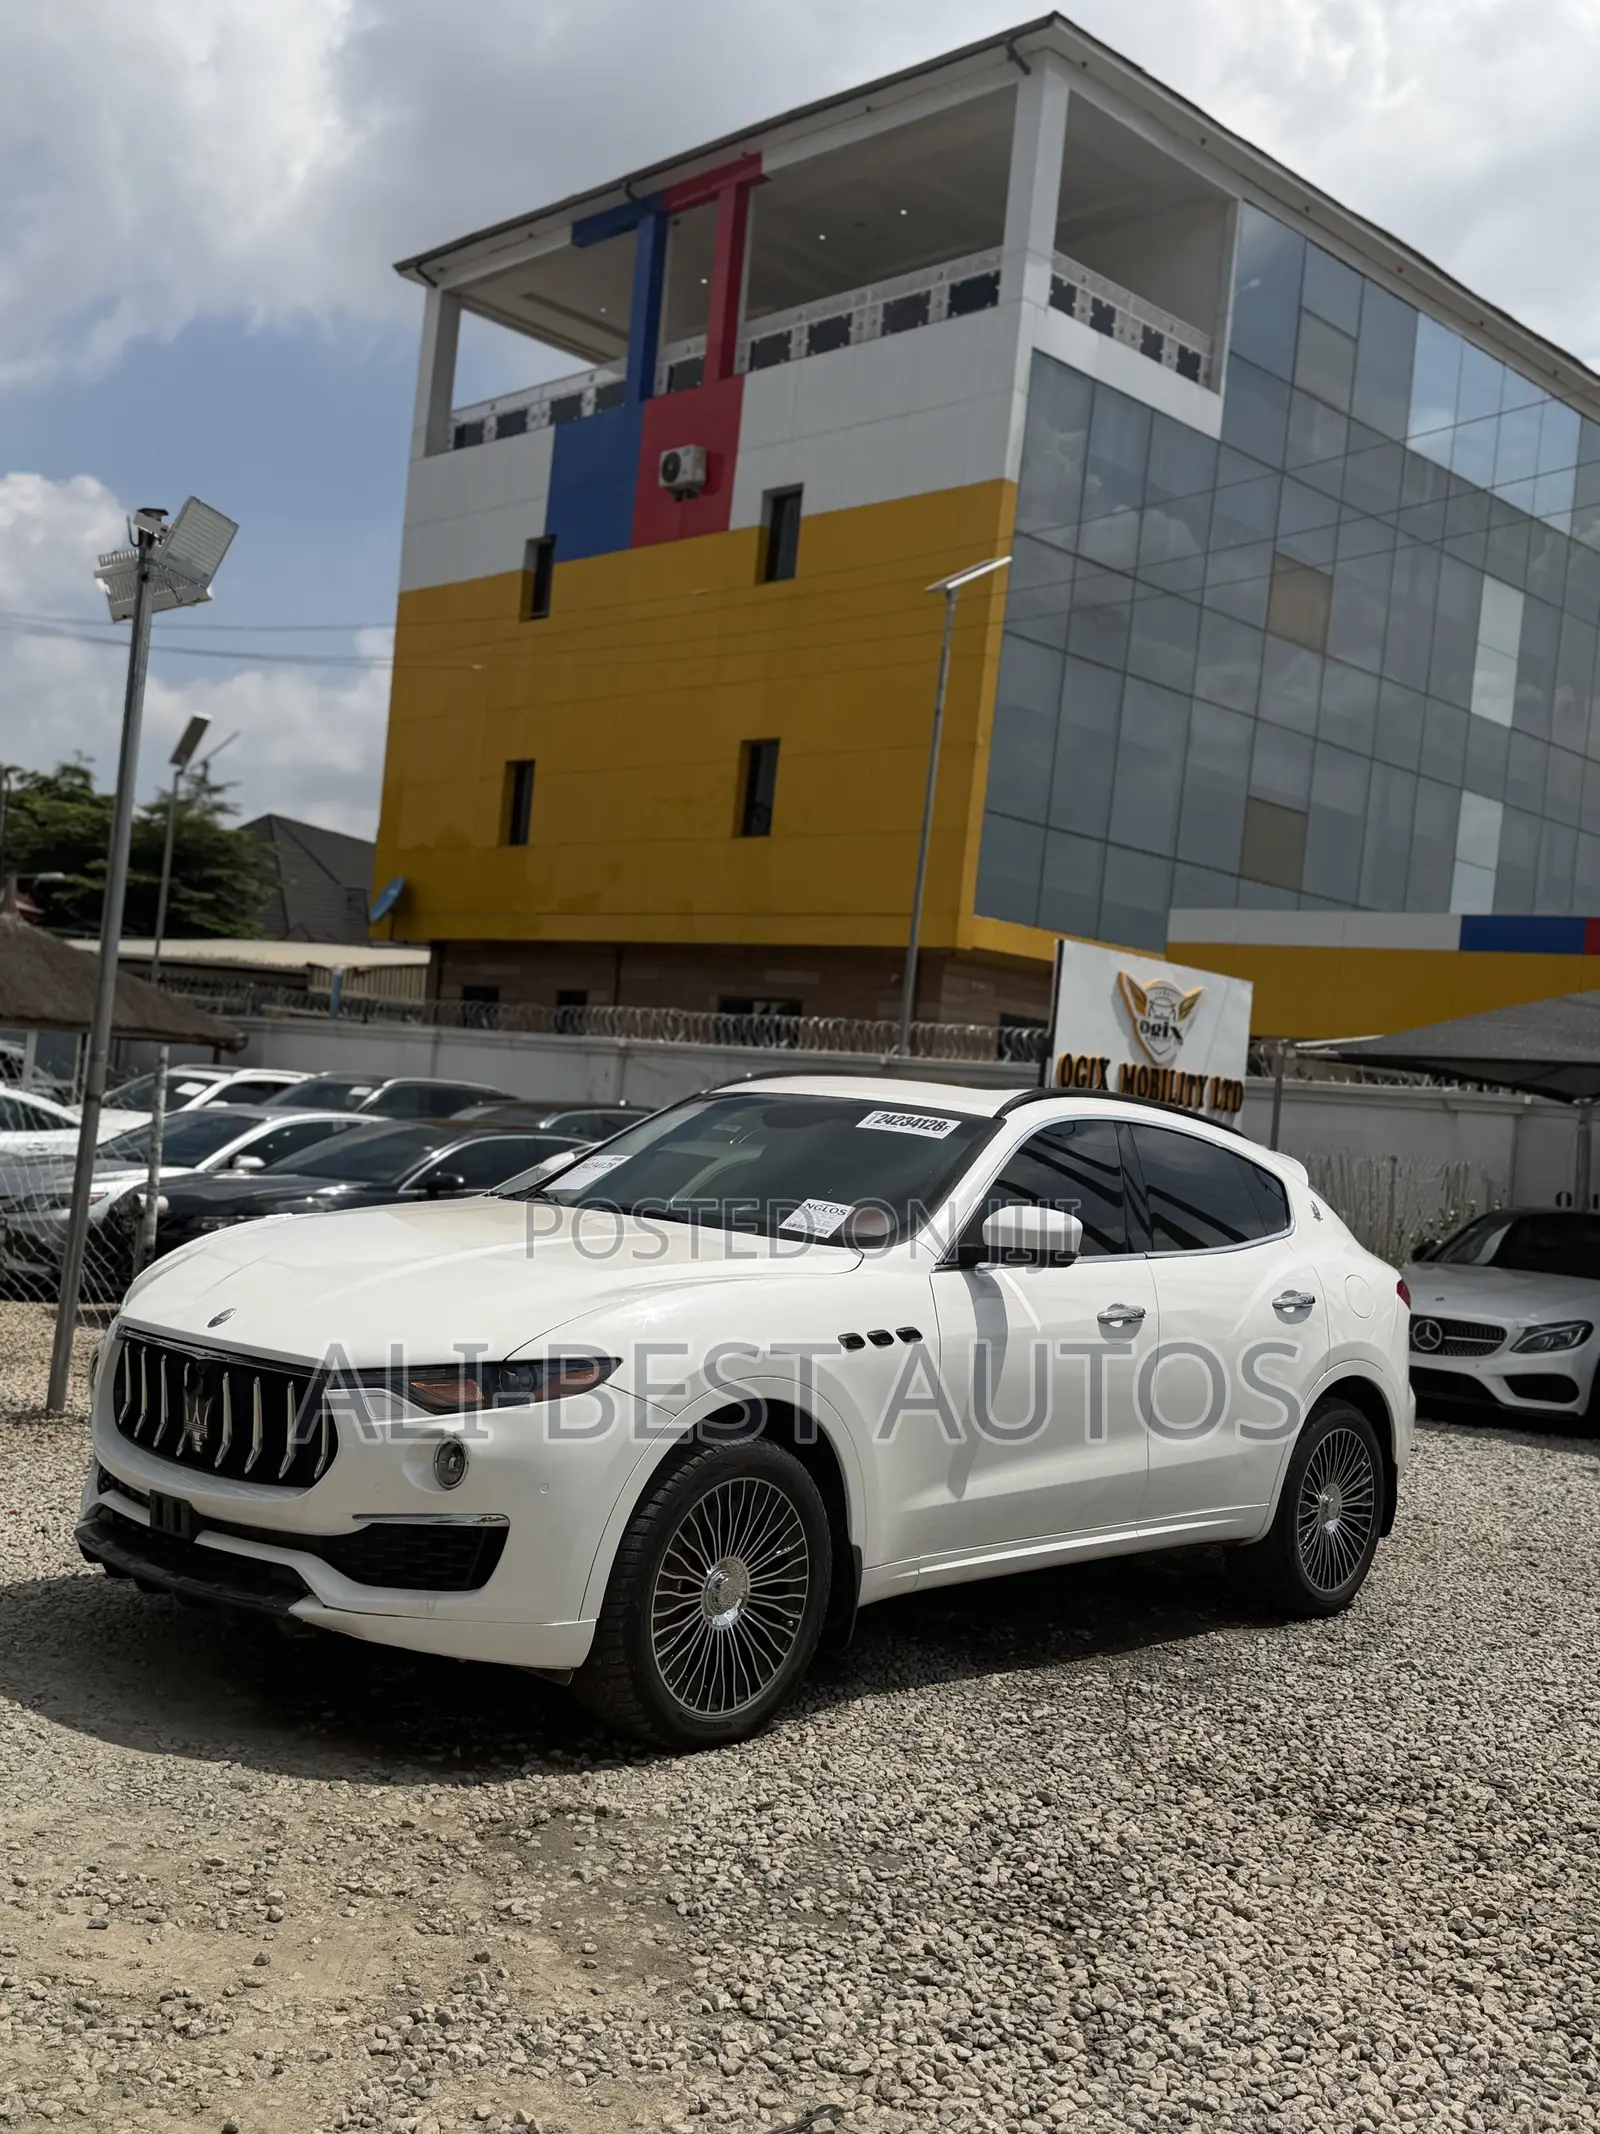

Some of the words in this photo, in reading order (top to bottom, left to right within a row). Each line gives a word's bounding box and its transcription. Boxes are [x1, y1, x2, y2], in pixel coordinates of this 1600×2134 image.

[1057, 1053, 1111, 1091] OGIX
[1118, 1063, 1208, 1110] MOBILITY
[1210, 1076, 1245, 1113] LTD
[803, 1202, 848, 1216] NGLOS
